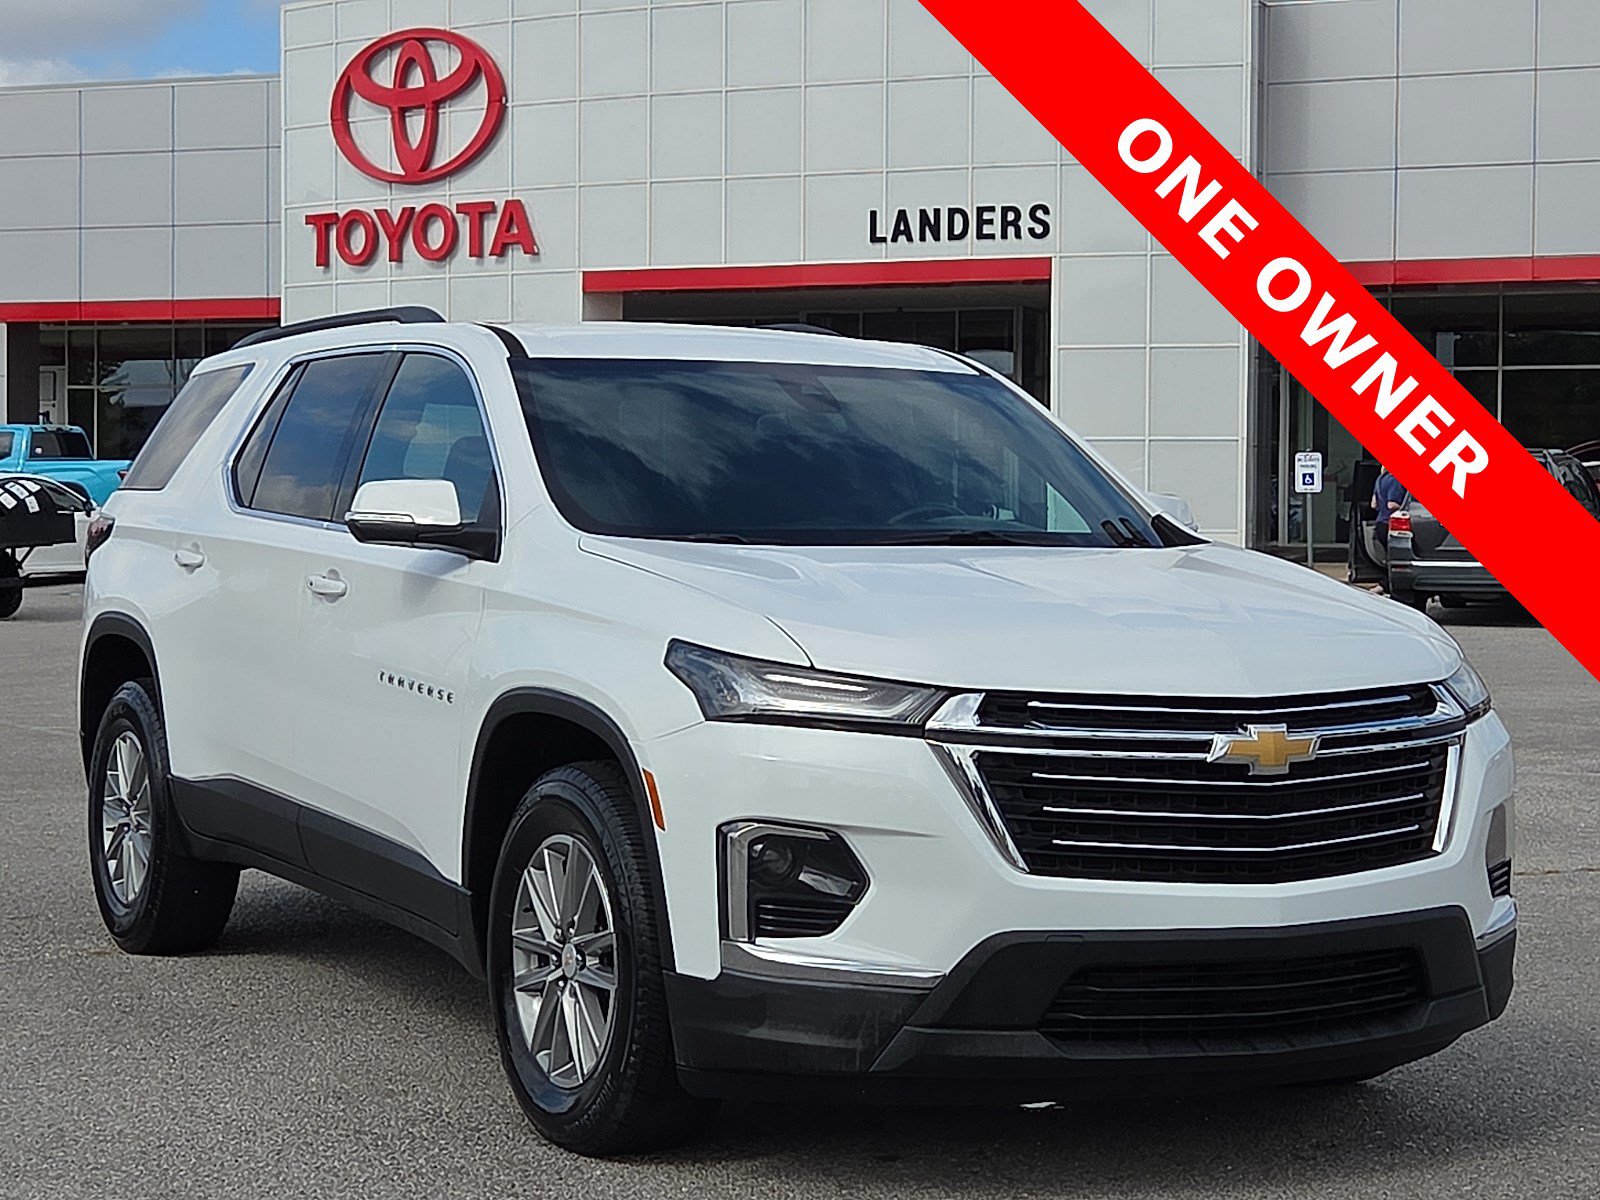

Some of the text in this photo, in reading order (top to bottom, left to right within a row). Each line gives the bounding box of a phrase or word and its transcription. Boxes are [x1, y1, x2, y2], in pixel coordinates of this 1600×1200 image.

[305, 199, 539, 268] TOYOTA
[869, 203, 1051, 244] LANDERS
[379, 670, 455, 704] TRAVERSE
